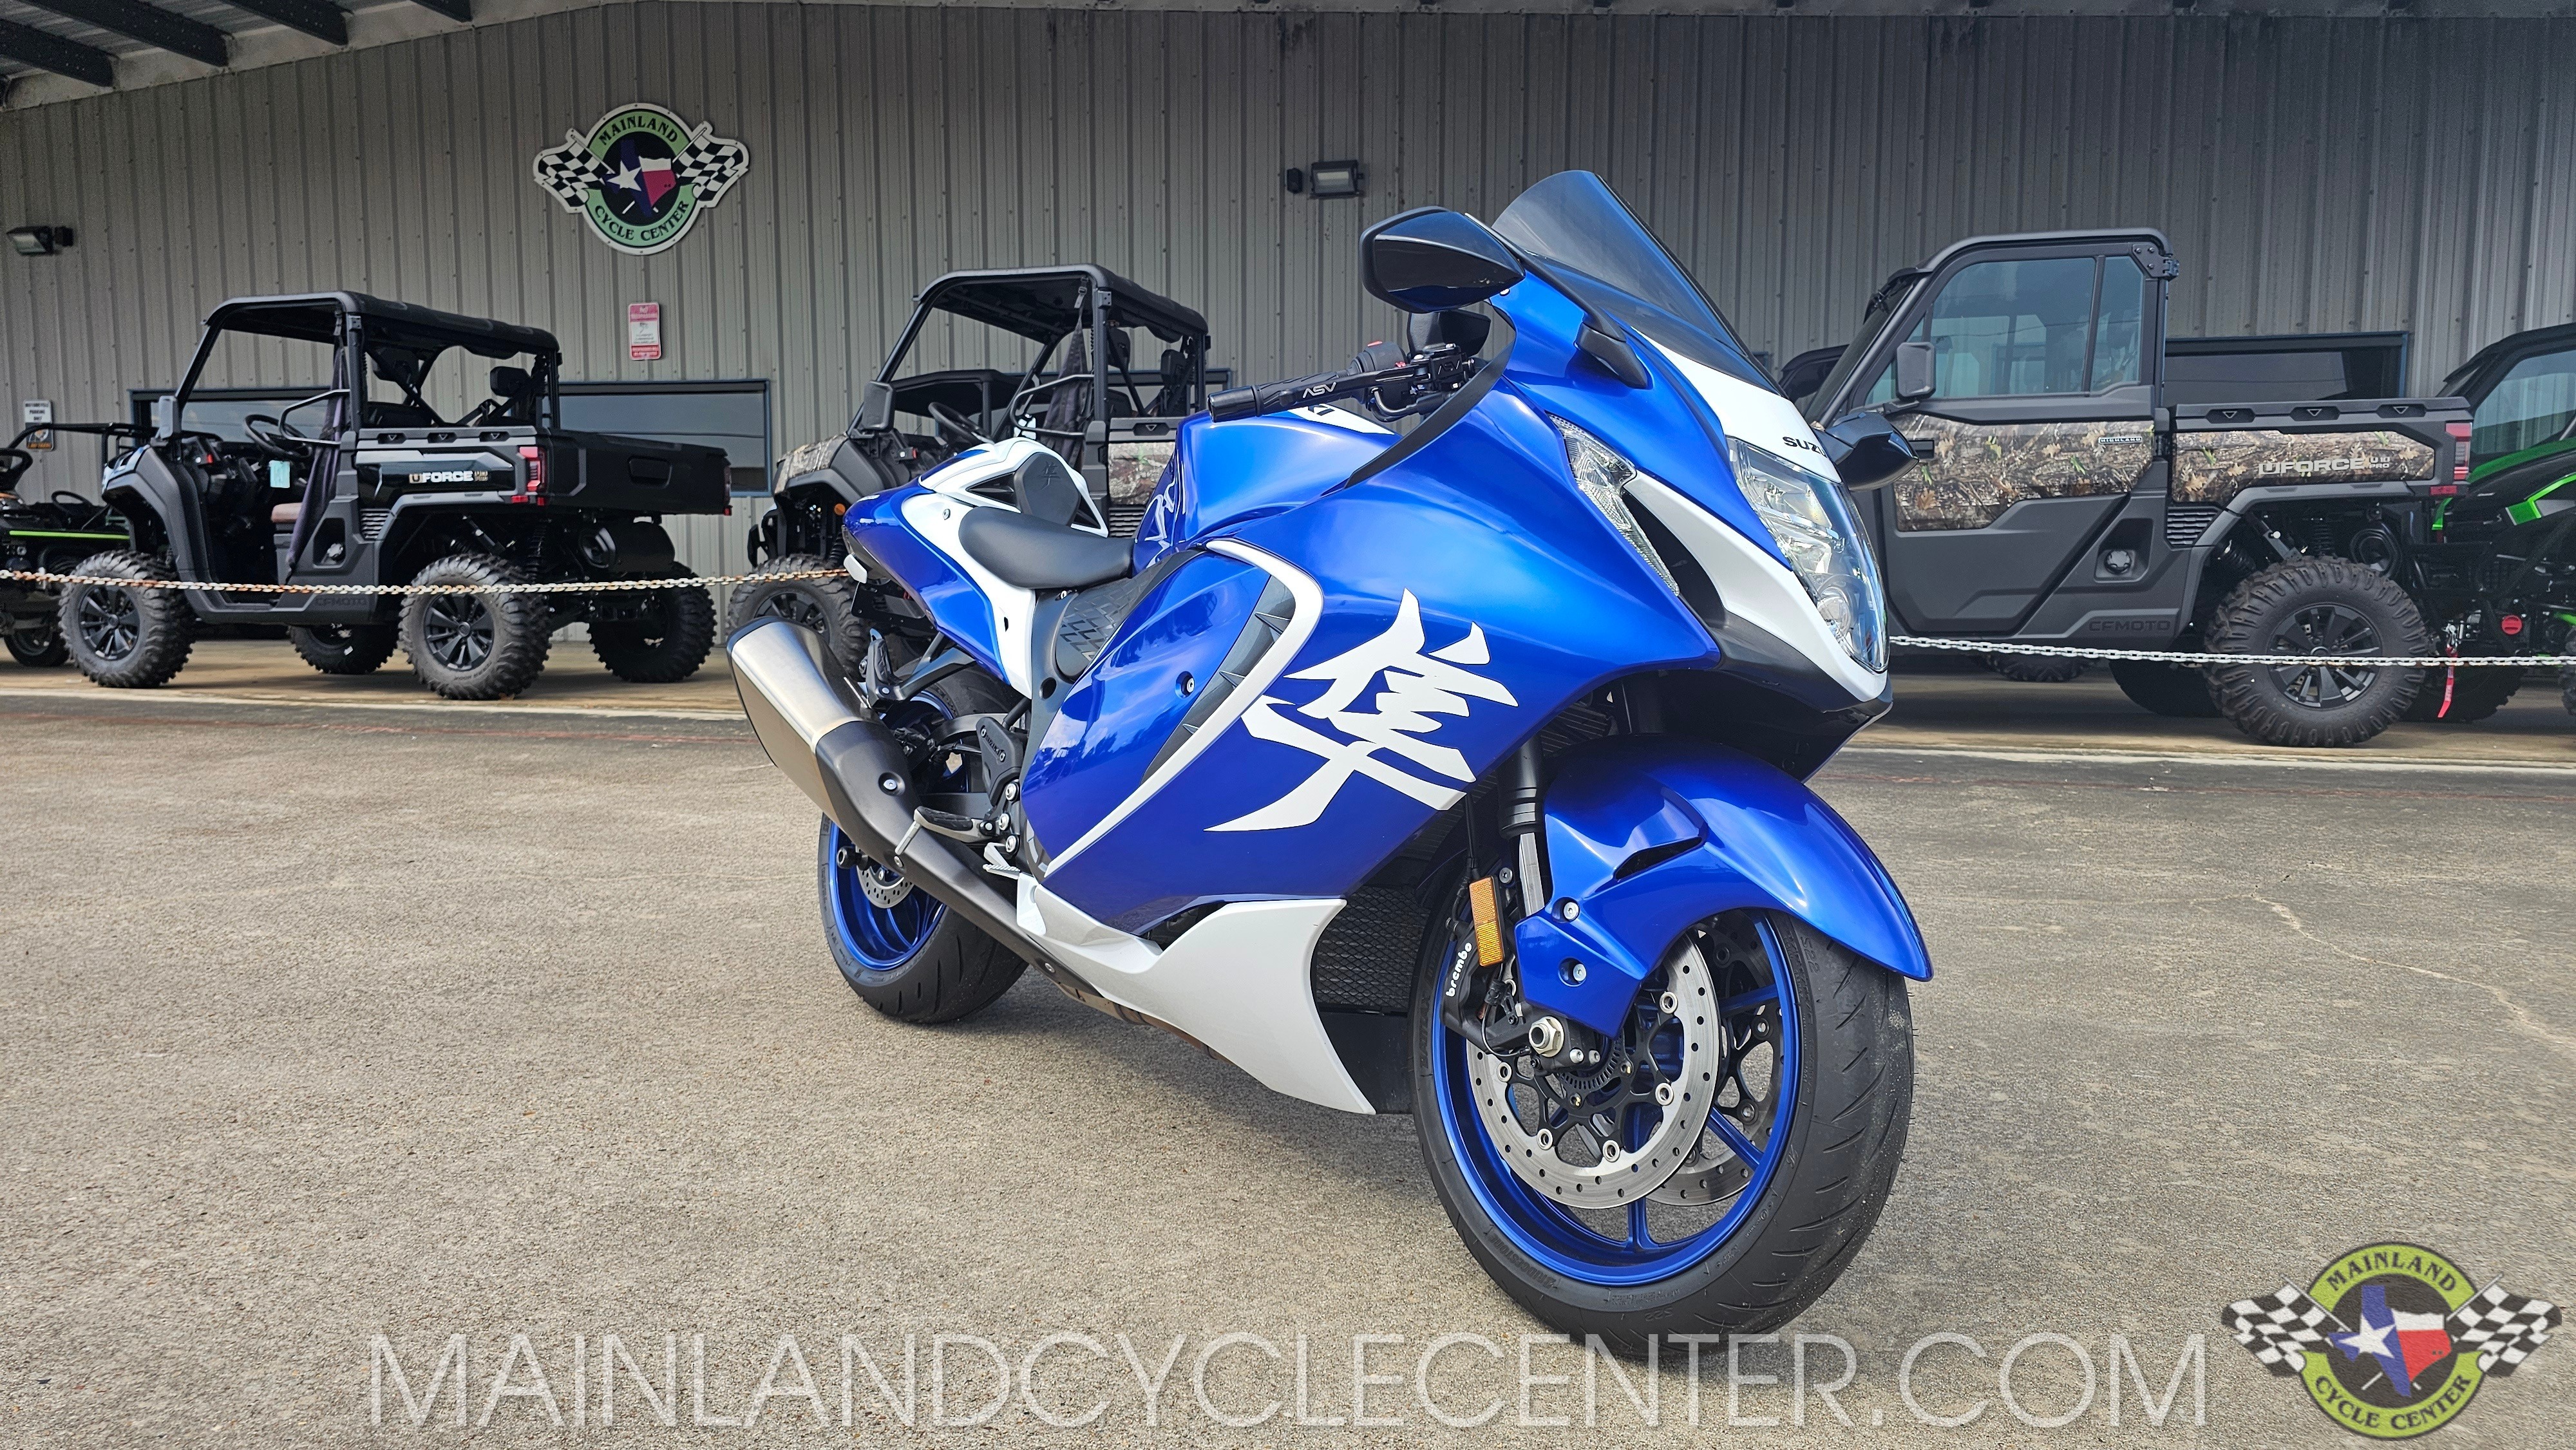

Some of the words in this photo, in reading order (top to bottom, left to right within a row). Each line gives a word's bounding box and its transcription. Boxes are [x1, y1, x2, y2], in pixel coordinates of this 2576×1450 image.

[598, 115, 678, 146] MAINLAND
[594, 204, 634, 240] CYCLE
[640, 200, 690, 241] CENTER
[1302, 382, 1337, 399] ASV
[409, 470, 474, 484] UFORCE
[2259, 458, 2365, 475] UFORCE
[2088, 620, 2171, 631] CFMOTO
[1203, 587, 1520, 832] 隼
[1801, 936, 1821, 973] S22
[1445, 942, 1473, 997] brembo
[1644, 1306, 1674, 1322] S22
